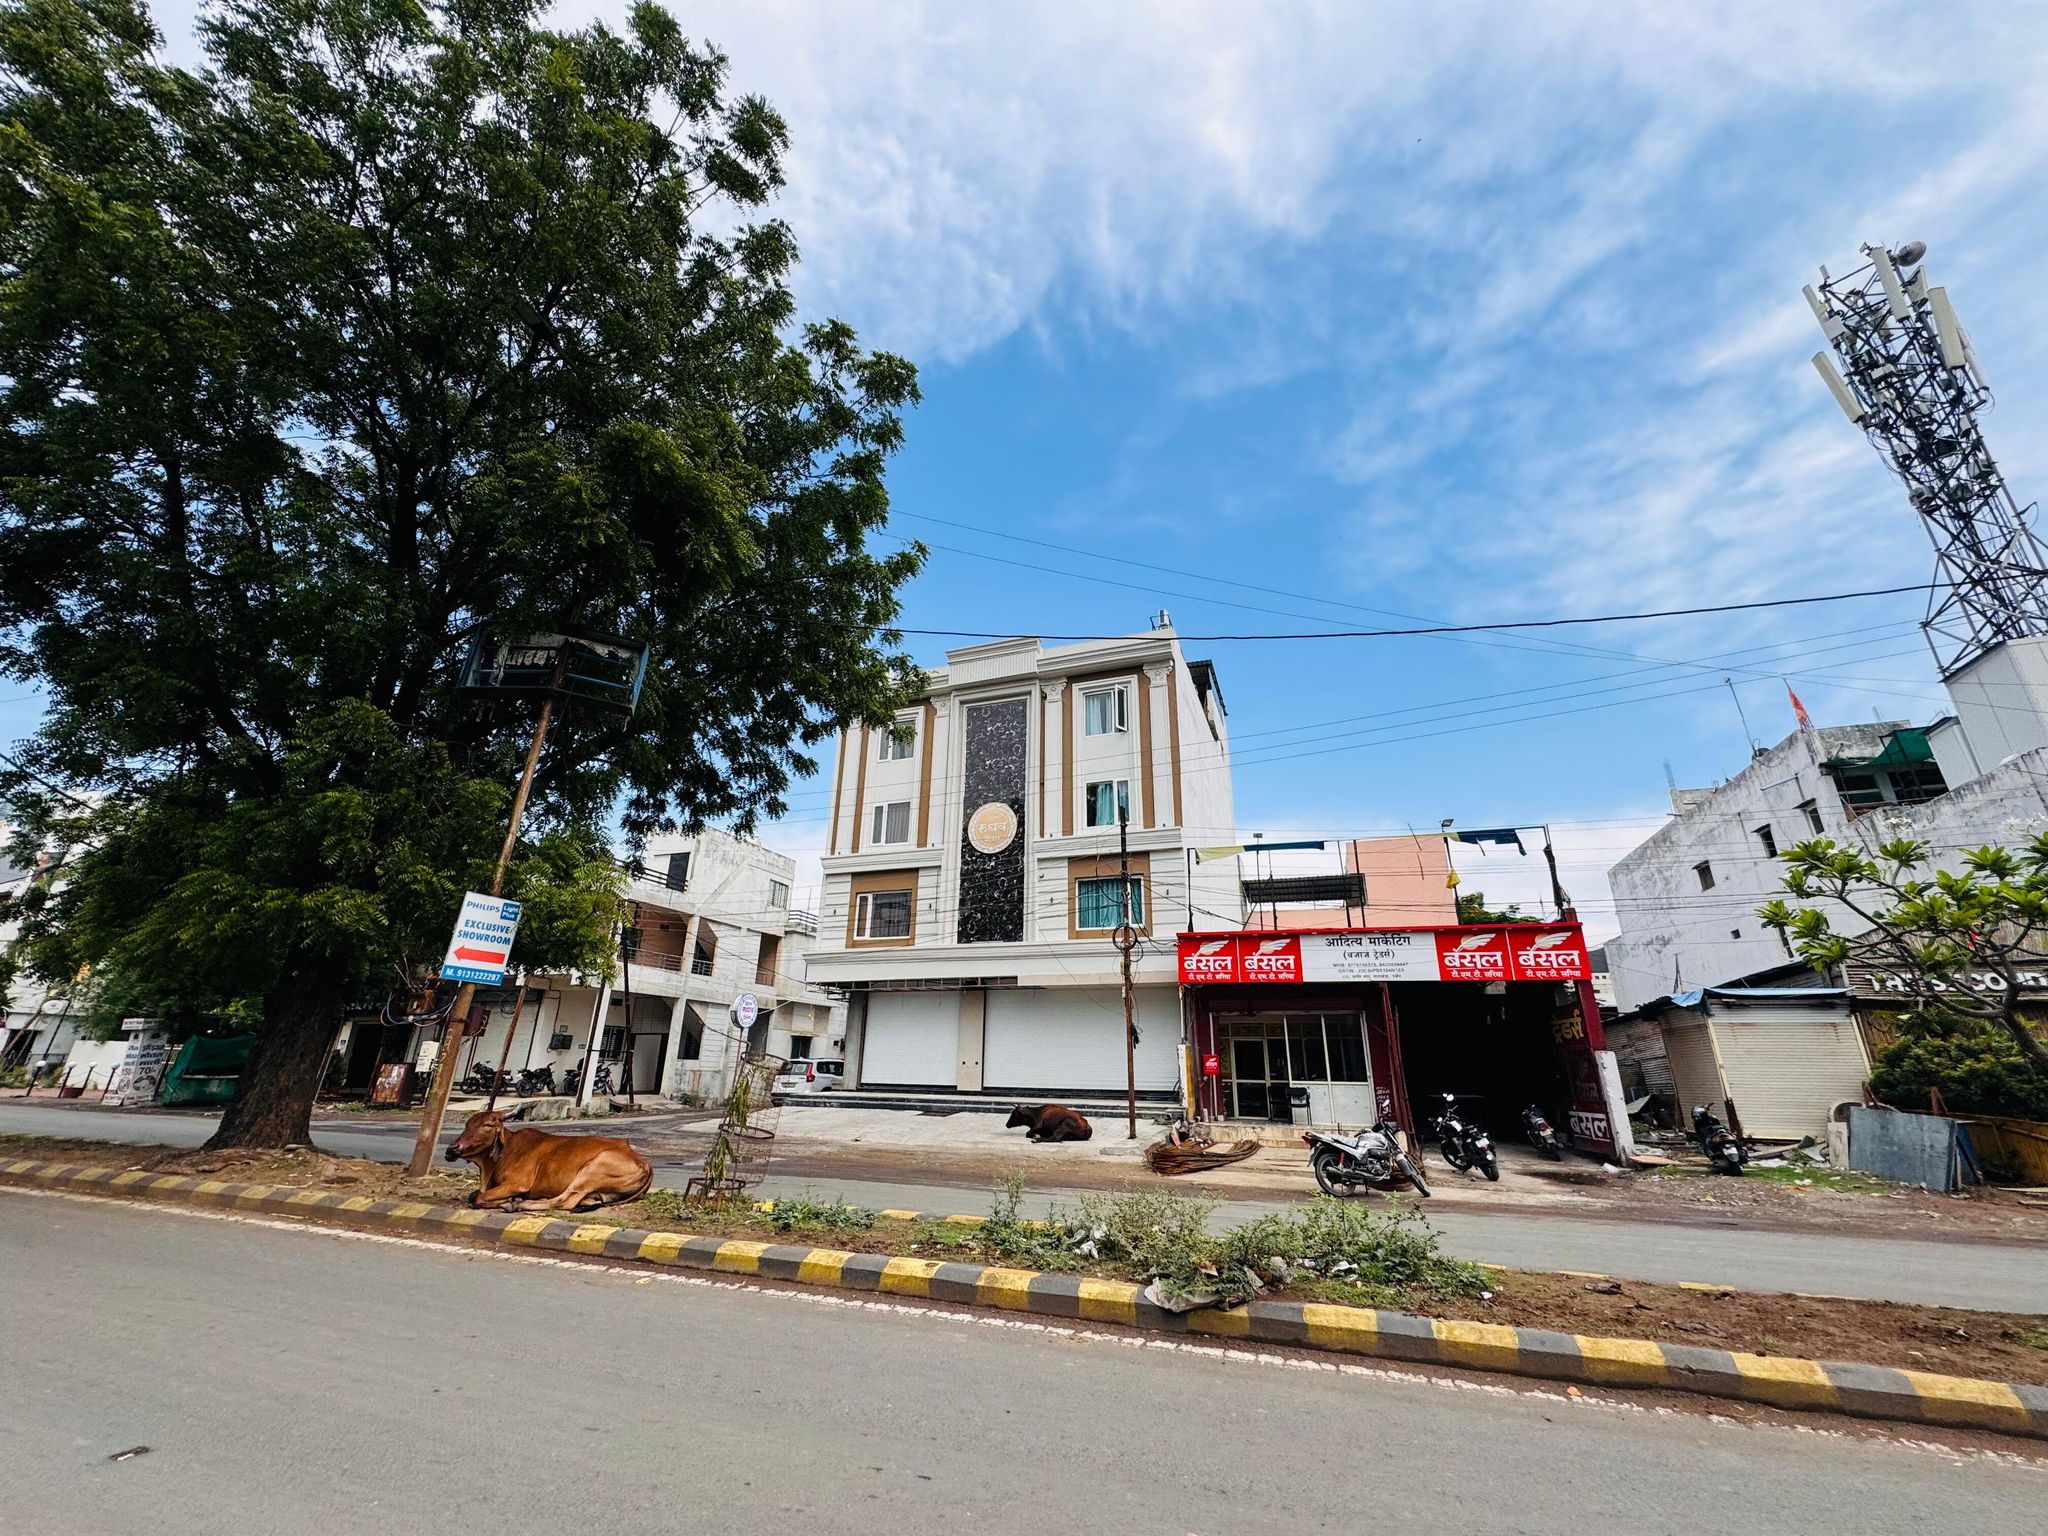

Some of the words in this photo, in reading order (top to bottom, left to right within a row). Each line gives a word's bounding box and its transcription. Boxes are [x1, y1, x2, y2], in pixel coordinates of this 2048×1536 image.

[466, 900, 500, 913] PHILIPS
[503, 905, 519, 913] Light
[464, 919, 511, 934] EXCLUSIVE
[457, 929, 511, 946] SHOWROOM
[1325, 934, 1363, 948] आदित्य
[1367, 933, 1411, 947] मार्केटिंग
[1184, 953, 1233, 972] बंसल
[1244, 952, 1296, 972] बंसल
[1443, 948, 1503, 968] बंसल
[1518, 946, 1581, 968] बंसल
[445, 967, 455, 977] M.
[1568, 1105, 1612, 1141] बंसल
